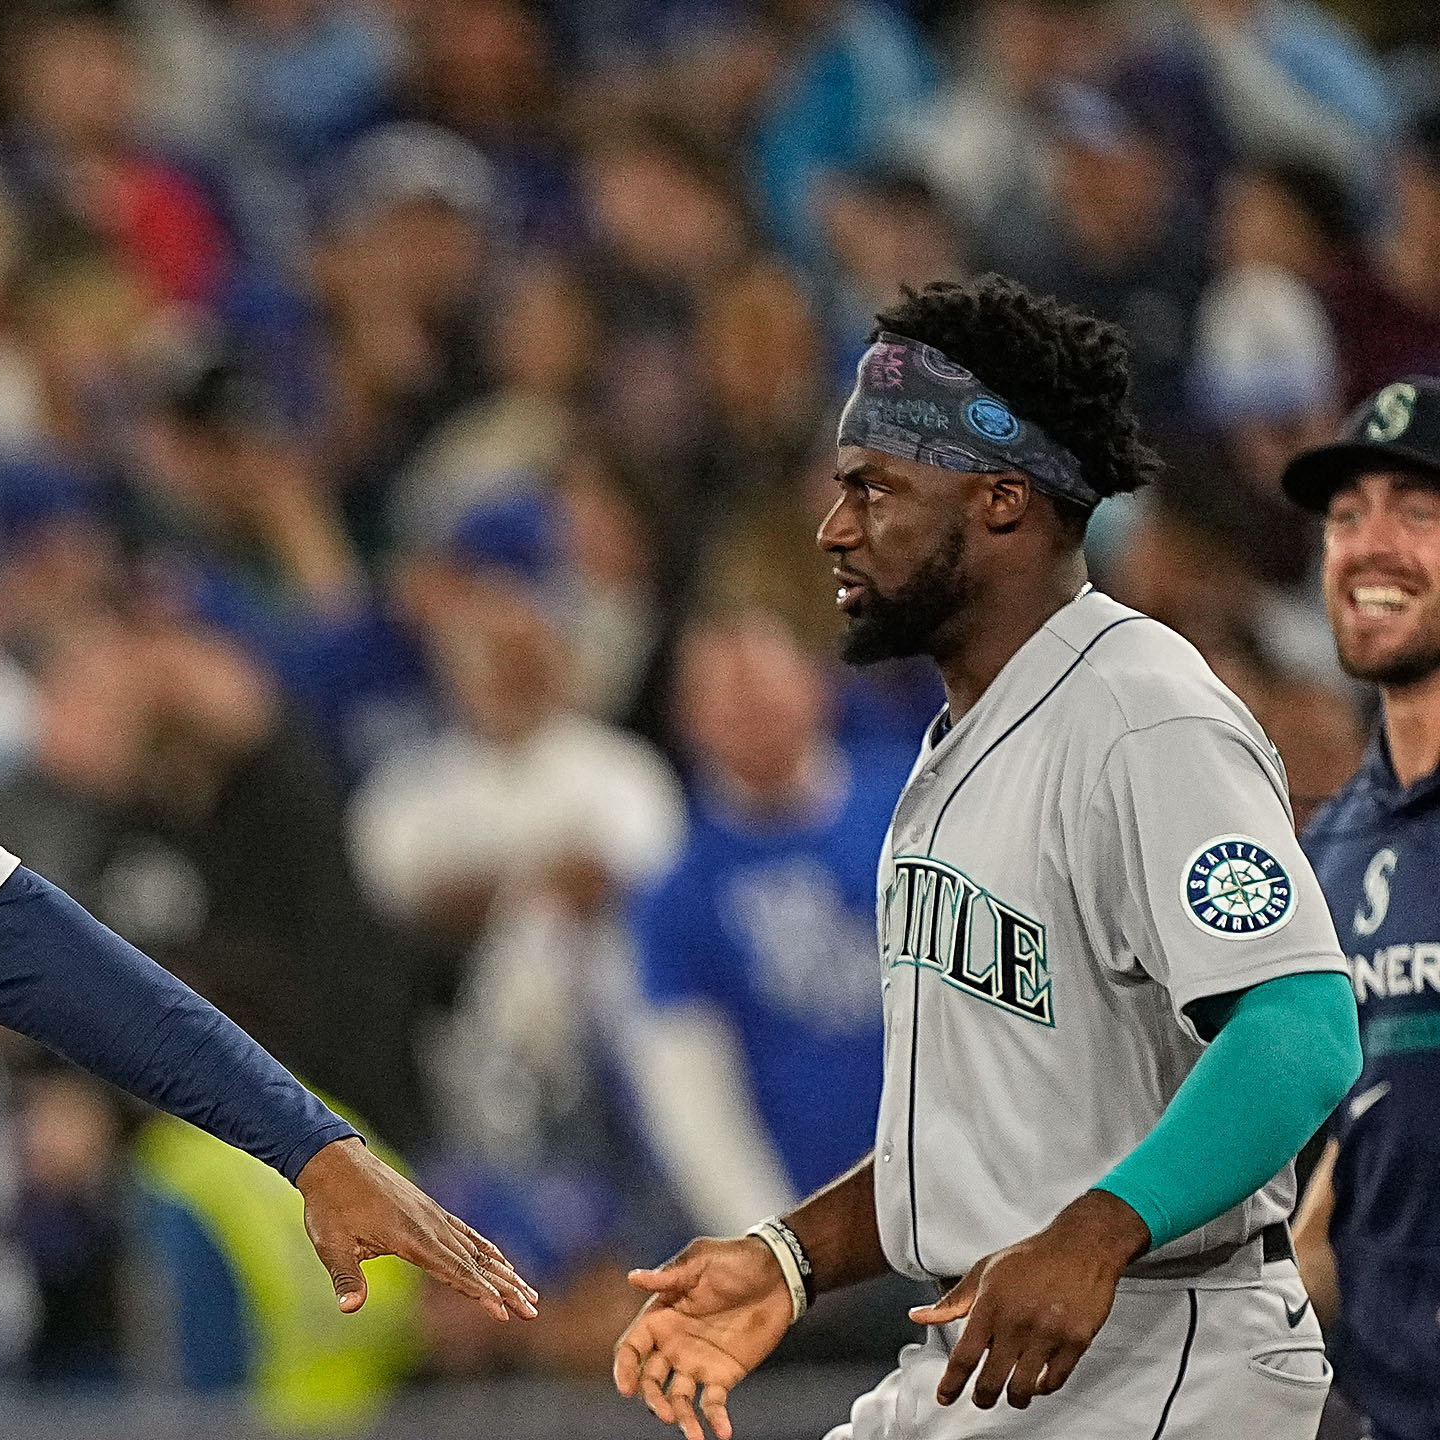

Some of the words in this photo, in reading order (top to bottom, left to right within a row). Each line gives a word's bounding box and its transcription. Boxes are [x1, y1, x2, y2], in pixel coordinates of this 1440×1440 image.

[1365, 382, 1417, 442] S
[1190, 843, 1275, 890] SEATTLE
[1353, 848, 1398, 935] S
[1201, 885, 1288, 930] MARINERS
